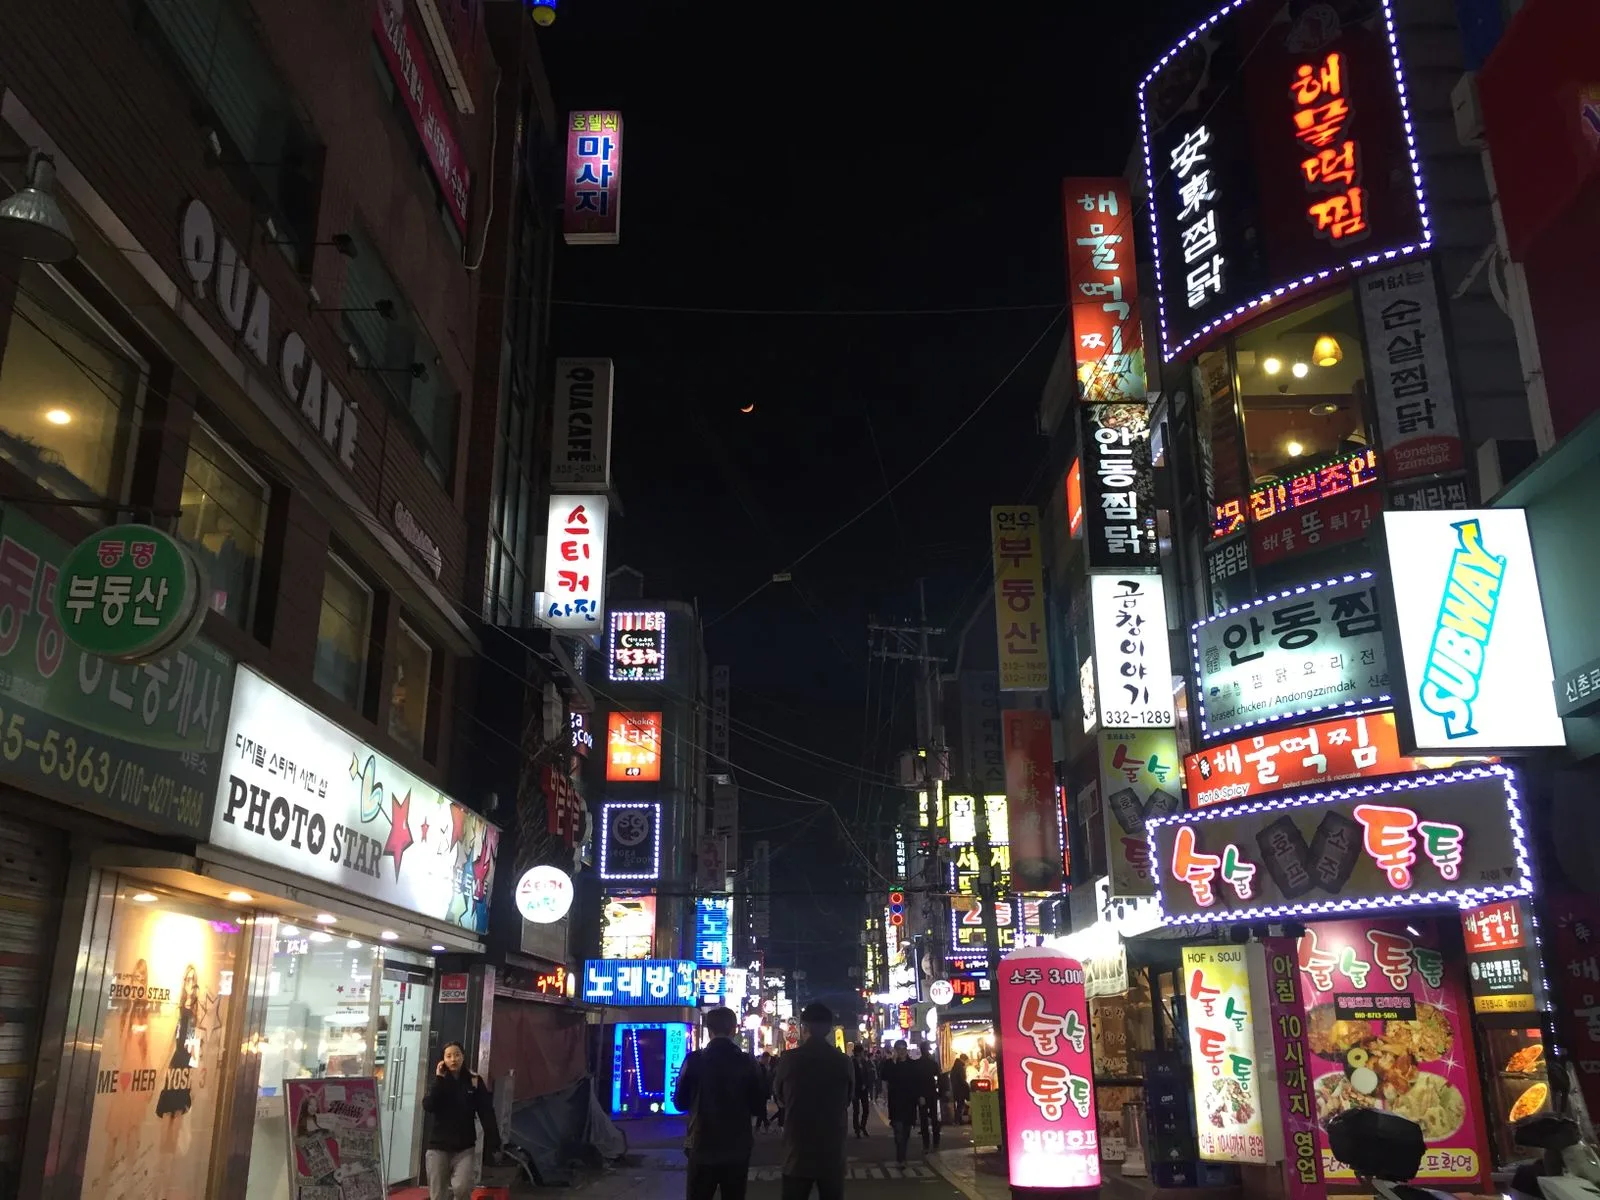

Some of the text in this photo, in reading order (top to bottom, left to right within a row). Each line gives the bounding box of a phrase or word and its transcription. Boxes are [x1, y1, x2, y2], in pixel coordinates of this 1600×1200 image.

[571, 114, 620, 132] 호텔식
[1287, 52, 1368, 240] 해물떡찜
[574, 135, 613, 217] 마사지
[1170, 124, 1225, 309] 安東찜닭
[184, 199, 270, 366] QUA
[1368, 271, 1424, 292] 뼈없는
[1381, 300, 1436, 434] 순살찜닭
[1393, 441, 1450, 467] boneless
[1397, 456, 1452, 481] zzimdak
[997, 507, 1034, 530] 연우
[1093, 424, 1149, 555] 안동찜닭
[98, 540, 157, 569] 동명
[560, 505, 590, 592] 스티커
[66, 574, 169, 626] 부동산
[548, 599, 597, 621] 사진
[1000, 536, 1039, 653] 부동산
[1222, 587, 1383, 667] 안동찜
[1419, 523, 1507, 738] SUBWAY
[1106, 711, 1172, 732] 332-1289
[1238, 696, 1268, 715] chicken
[1275, 680, 1356, 707] Andongzzimdak
[1113, 744, 1170, 783] 술술
[1214, 717, 1377, 785] 해물떡찜
[299, 769, 317, 794] 사진
[1198, 781, 1250, 805] Hot & Spicy
[223, 774, 382, 879] PHOTO STAR
[1353, 804, 1464, 890] 통통
[518, 875, 563, 895] 스티커
[1172, 826, 1258, 907] 술술
[1316, 827, 1350, 886] 소주
[522, 888, 557, 912] 사진
[1466, 904, 1520, 942] 해물떡찜
[585, 965, 676, 999] 노래방
[701, 914, 726, 995] 노래방
[1010, 968, 1043, 984] 소주
[1187, 953, 1207, 972] HOF
[1217, 953, 1241, 970] SOJU
[1297, 928, 1371, 992] 술술
[1367, 929, 1444, 991] 통통
[109, 982, 171, 1001] PHOTO STAR
[1190, 968, 1248, 1033] 술술
[1018, 990, 1086, 1057] 술술
[97, 1069, 118, 1095] ME
[131, 1069, 157, 1093] HER
[1194, 1026, 1253, 1090] 통통
[1273, 955, 1319, 1186] 아침 10시까지 영업
[1021, 1056, 1092, 1121] 통통
[1248, 1135, 1264, 1158] 영업
